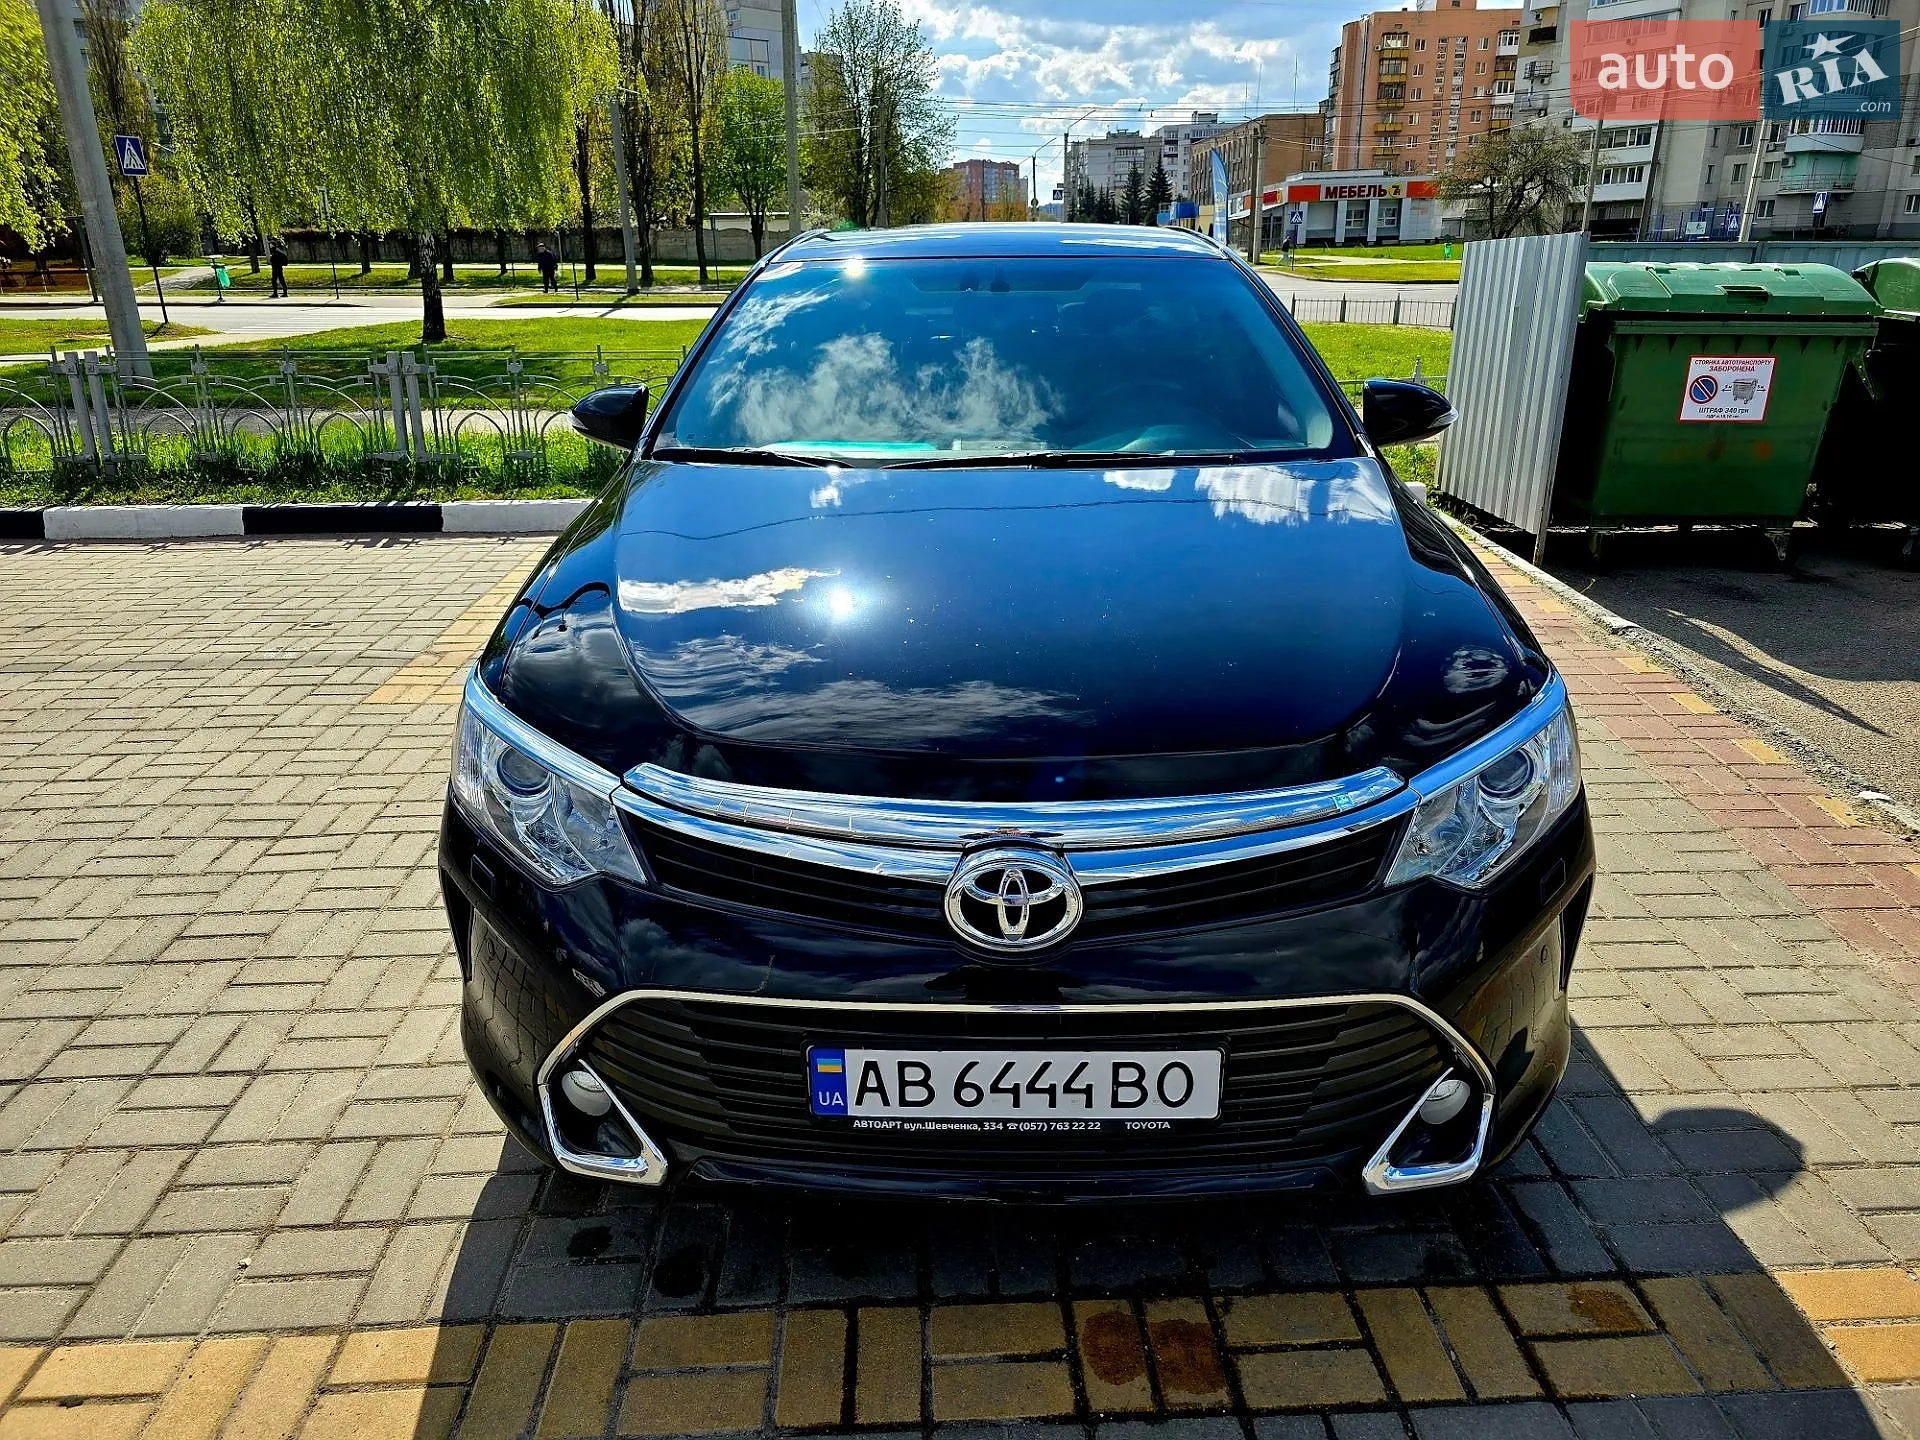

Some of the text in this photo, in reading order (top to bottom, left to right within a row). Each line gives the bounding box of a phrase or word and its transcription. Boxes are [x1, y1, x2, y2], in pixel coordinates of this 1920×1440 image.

[1324, 184, 1388, 200] МЕБЕЛЬ
[854, 1060, 936, 1108] AB
[953, 1060, 1094, 1109] 6444
[818, 1091, 844, 1106] UA
[853, 1119, 1101, 1132] АВТОАРТ вул.Шевченка, 334 (057) 763 22 22
[1125, 1121, 1171, 1130] TOYOTA
